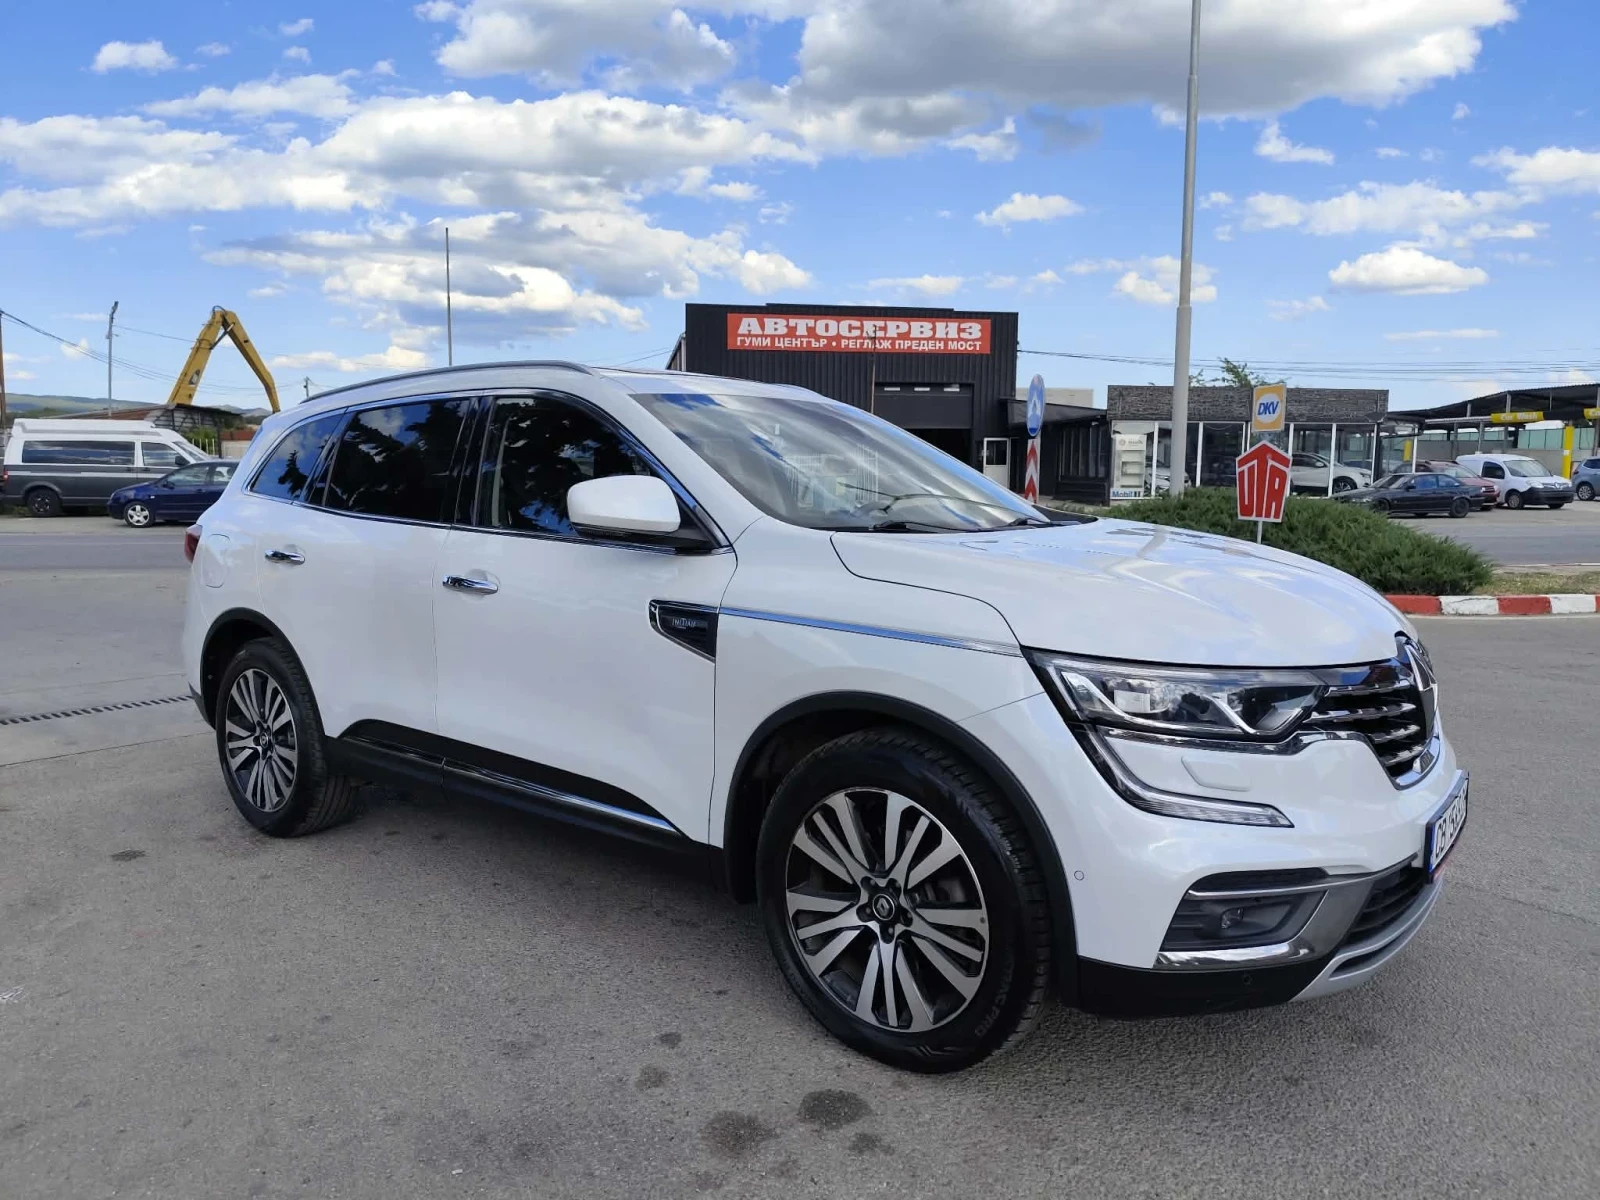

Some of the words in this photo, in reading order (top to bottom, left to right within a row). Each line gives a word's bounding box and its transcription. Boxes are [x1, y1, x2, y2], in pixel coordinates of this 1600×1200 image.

[737, 317, 982, 339] АВТОСЕРВИЗ
[737, 336, 771, 347] ГУМИ
[775, 337, 827, 349] ЦЕНТЪР
[841, 339, 891, 350] РЕГЛАЖ
[895, 340, 944, 351] ПРЕДЕН
[948, 341, 982, 351] МОСТ
[1257, 401, 1279, 415] DKV
[1237, 443, 1289, 519] UTA
